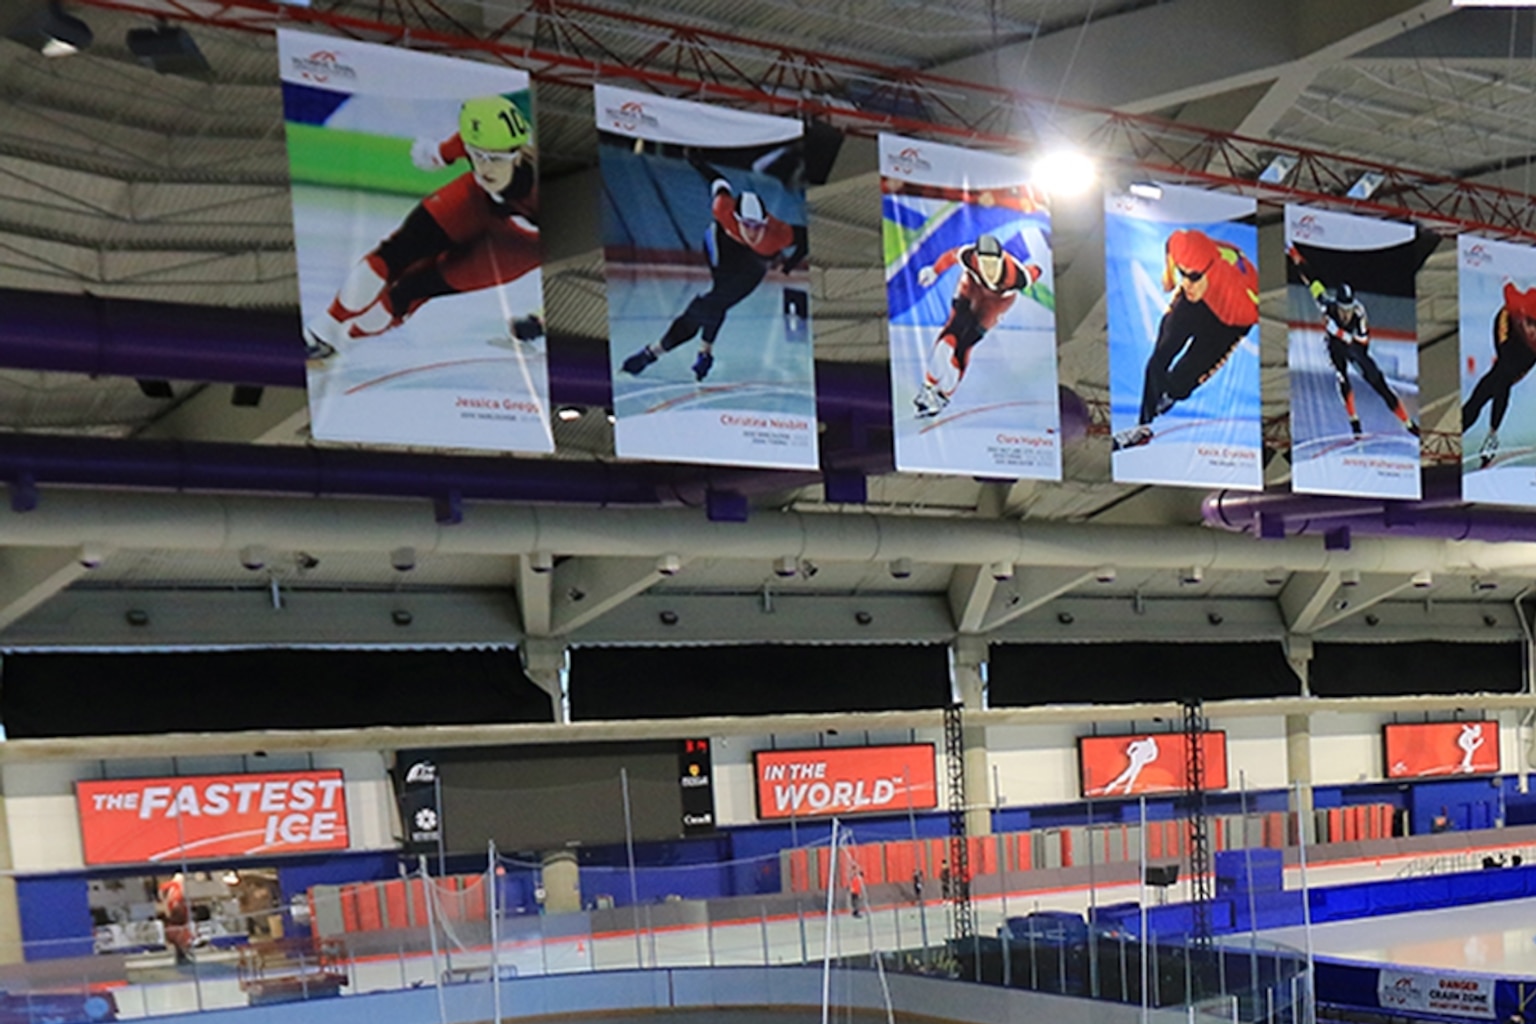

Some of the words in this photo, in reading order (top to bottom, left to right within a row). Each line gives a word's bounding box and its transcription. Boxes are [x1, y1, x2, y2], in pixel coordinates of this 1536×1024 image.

[765, 765, 783, 781] IN
[790, 763, 826, 779] THE
[92, 792, 139, 811] THE
[139, 778, 343, 820] FASTEST
[264, 811, 338, 846] ICE
[1439, 979, 1479, 991] DANGER
[1429, 989, 1460, 1000] CRASH
[1462, 993, 1488, 1004] ZONE
